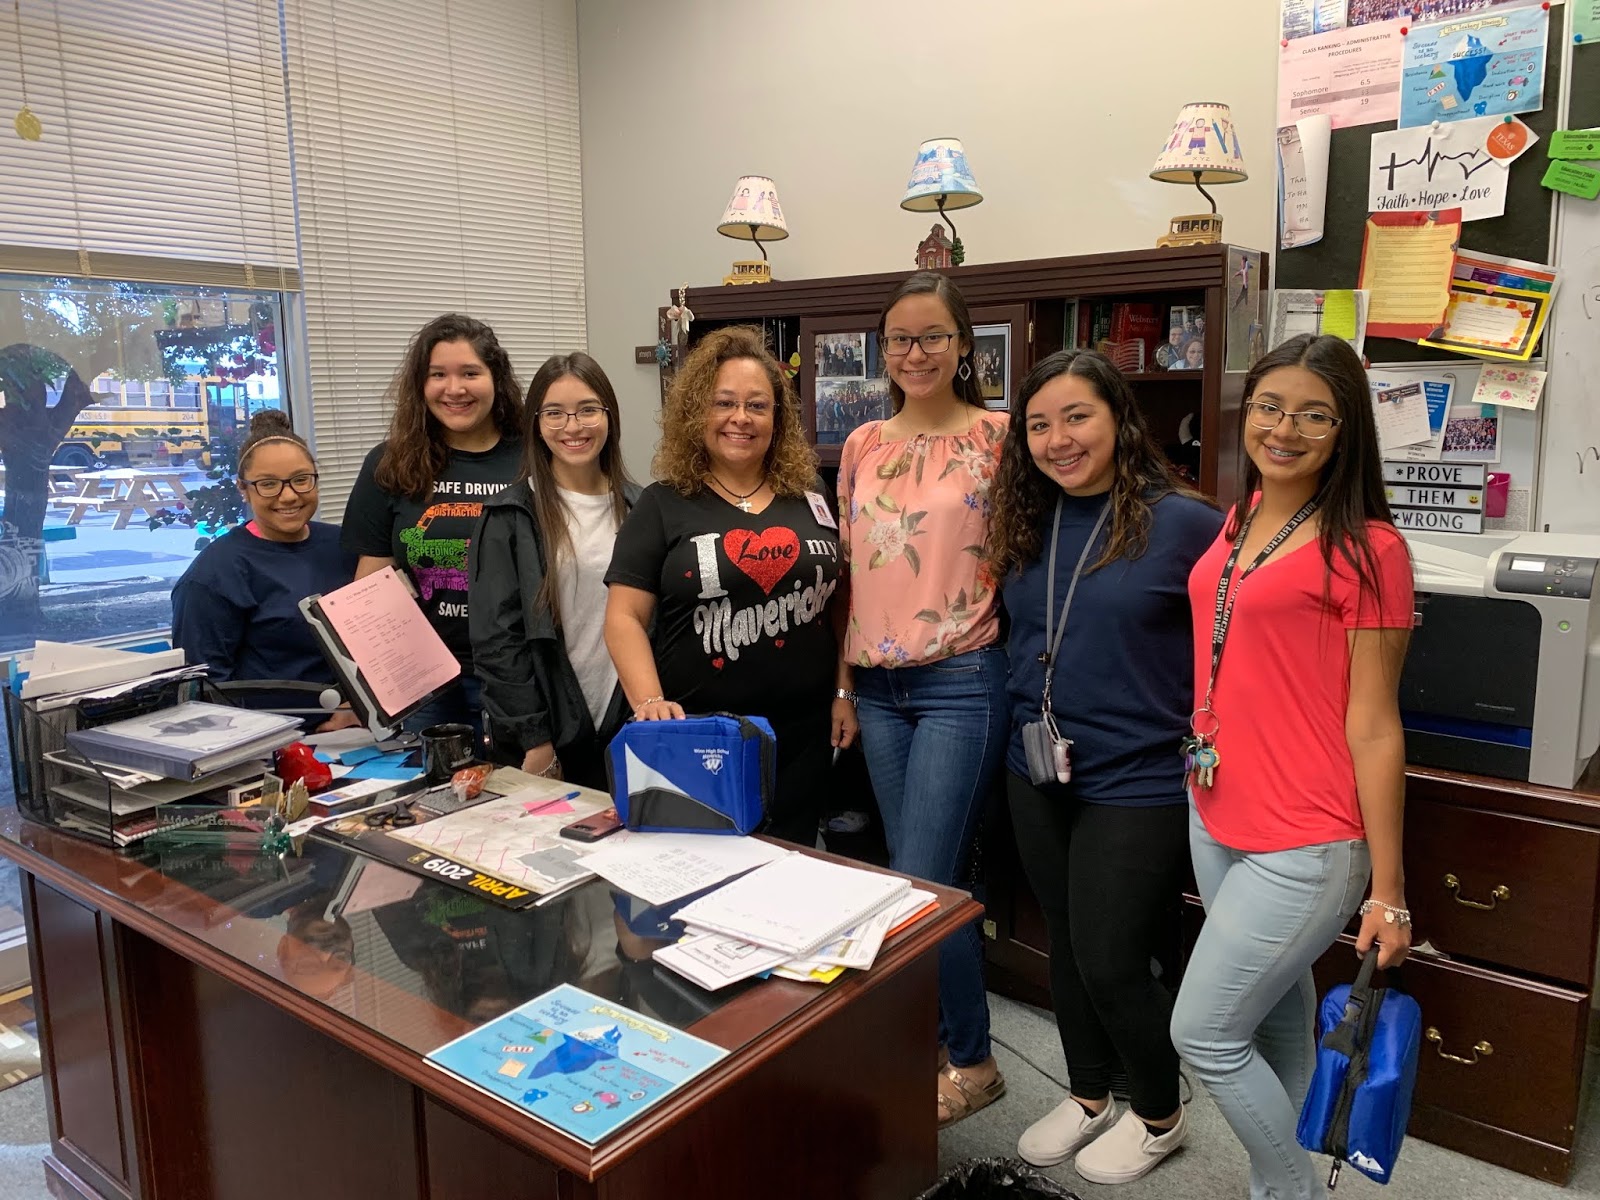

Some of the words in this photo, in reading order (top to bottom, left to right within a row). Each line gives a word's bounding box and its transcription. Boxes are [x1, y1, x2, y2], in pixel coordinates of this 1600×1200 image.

[1302, 47, 1317, 55] CLASS
[1317, 42, 1342, 51] RANKING
[1346, 33, 1391, 46] ADMINISTRATIVE
[1328, 47, 1362, 57] PROCEDURES
[1292, 86, 1329, 98] Sophomore
[1299, 107, 1320, 115] Senior
[1495, 132, 1515, 150] TEXAS
[1377, 193, 1409, 210] Faith
[1418, 190, 1450, 208] Hope
[1460, 185, 1491, 201] Love
[1406, 466, 1462, 483] PROVE
[432, 480, 462, 494] SAFE
[465, 482, 512, 496] DRIVIN
[1407, 489, 1455, 505] THEM
[1402, 511, 1463, 530] WRONG
[416, 546, 454, 556] SPEEDING
[689, 532, 729, 599] I
[736, 538, 794, 566] Love
[805, 539, 838, 563] my
[438, 601, 468, 617] SAVE
[162, 814, 188, 825] Aida
[423, 858, 474, 880] 2019
[467, 873, 529, 899] APRIL
